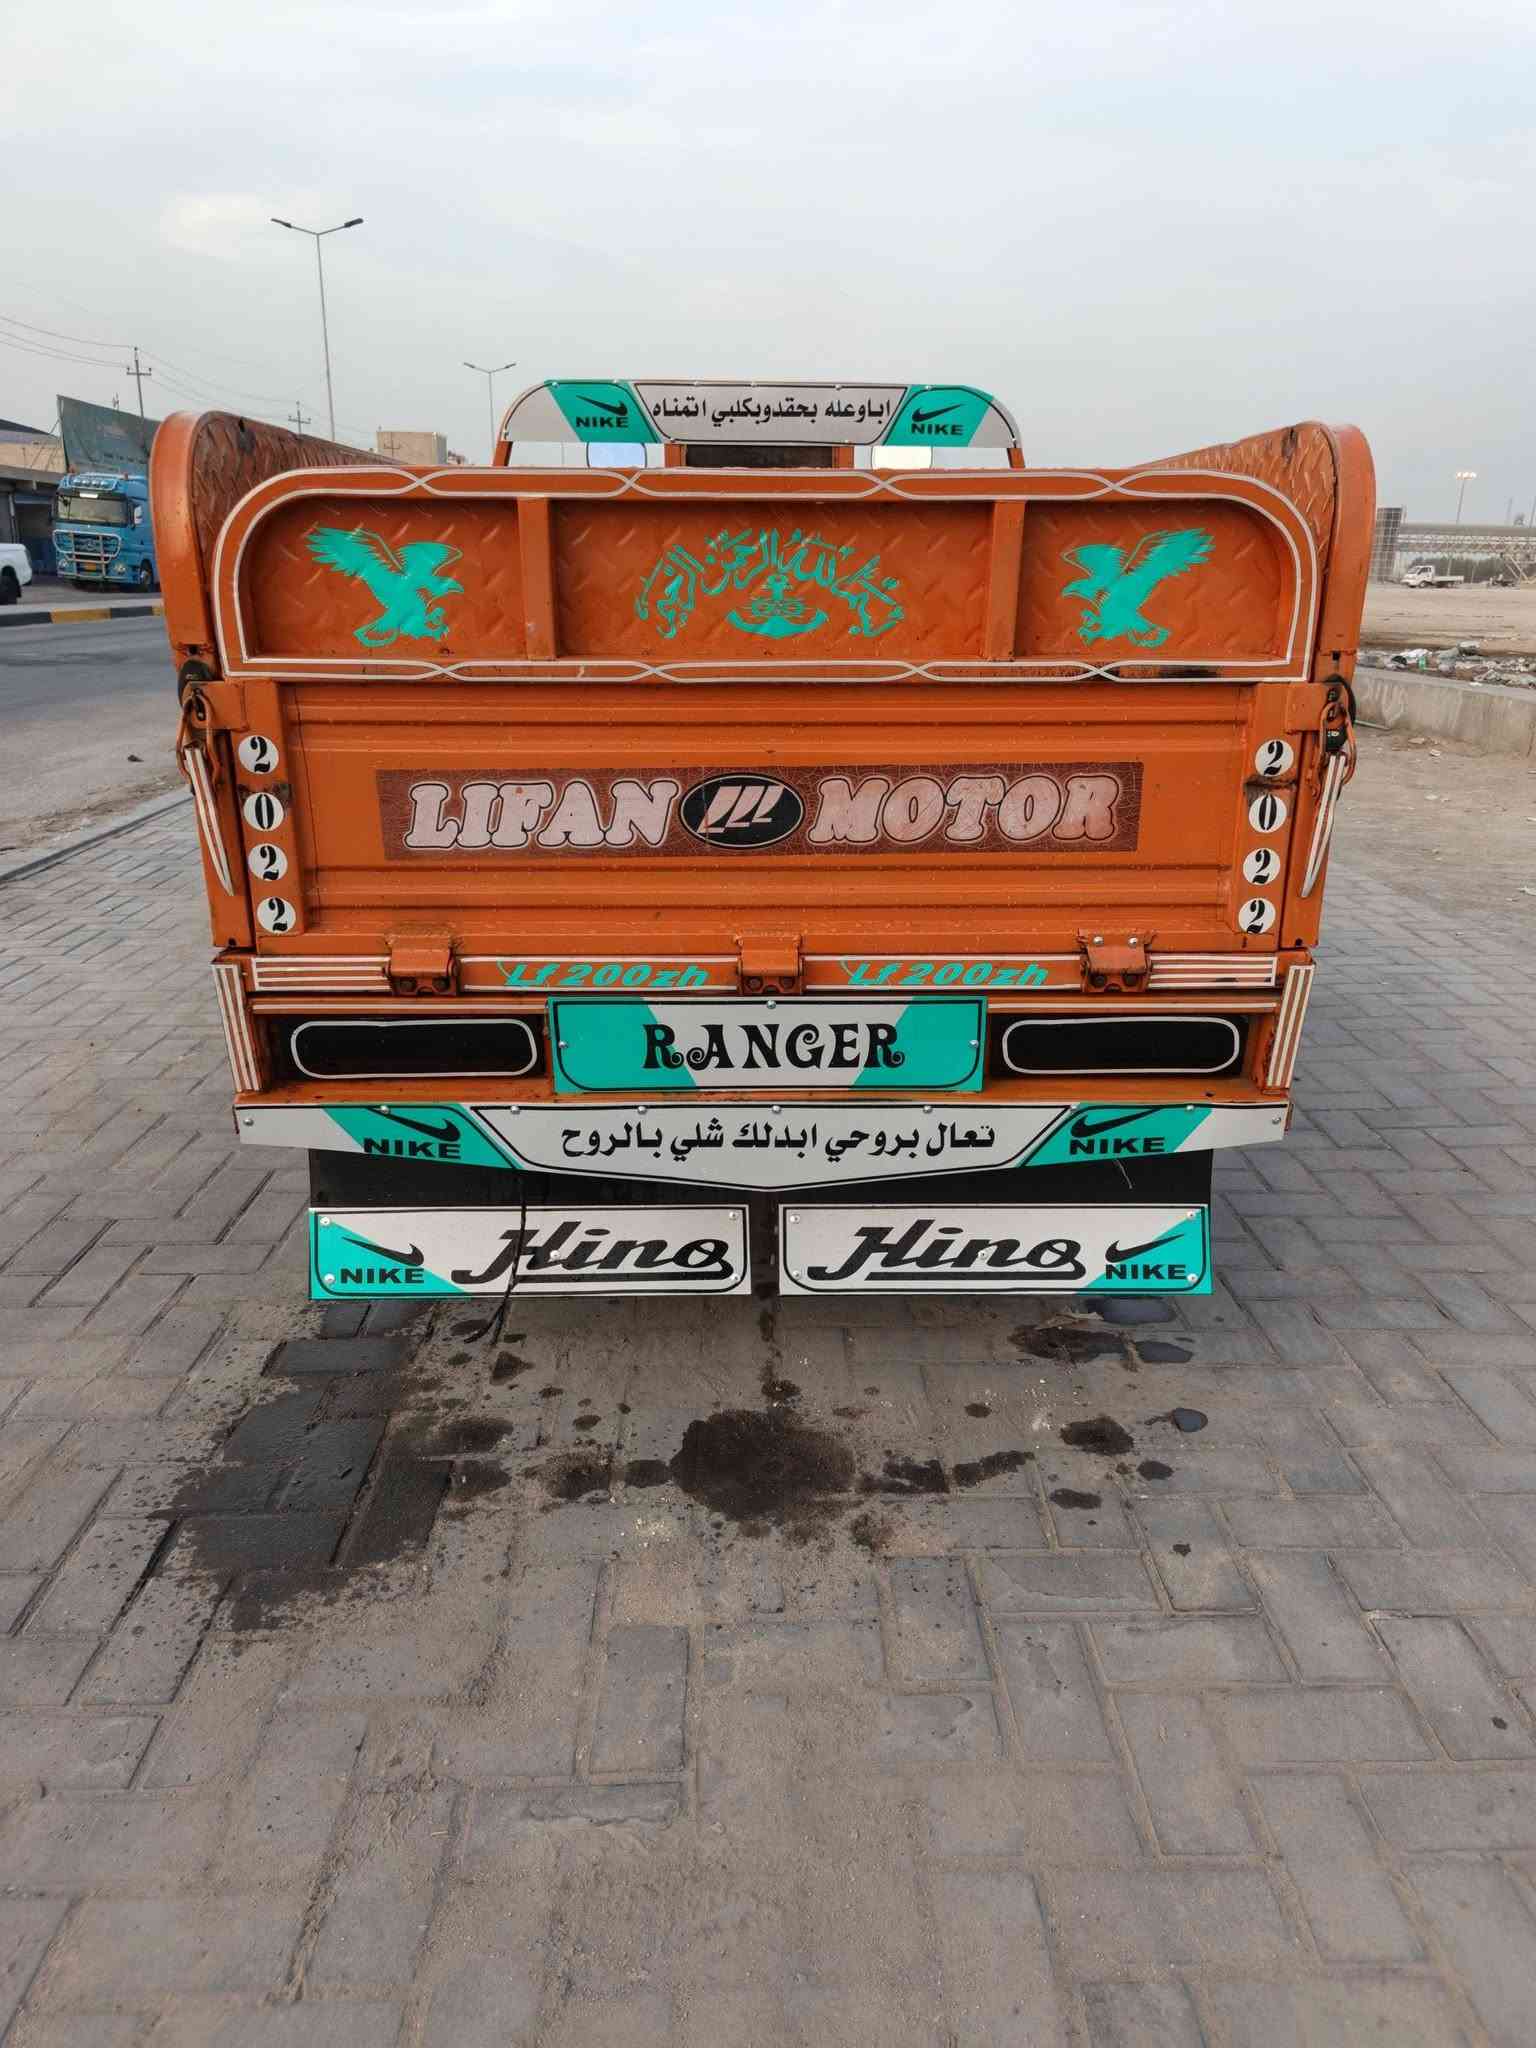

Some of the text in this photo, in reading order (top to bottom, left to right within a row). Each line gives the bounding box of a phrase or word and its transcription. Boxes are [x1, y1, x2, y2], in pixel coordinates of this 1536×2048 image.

[575, 416, 629, 428] NIKE
[911, 424, 965, 436] NIKE
[403, 774, 1121, 850] LIFAN MOTOR
[642, 1023, 905, 1070] RANGER
[363, 1138, 462, 1160] NIKE
[561, 1117, 995, 1163] تعال بروحي ابدلك شلي بالروح
[1069, 1136, 1166, 1156] NIKE
[450, 1220, 735, 1284] Hino
[806, 1218, 1087, 1282] Hino
[340, 1267, 425, 1285] NIKE
[1104, 1263, 1188, 1281] NIKE
